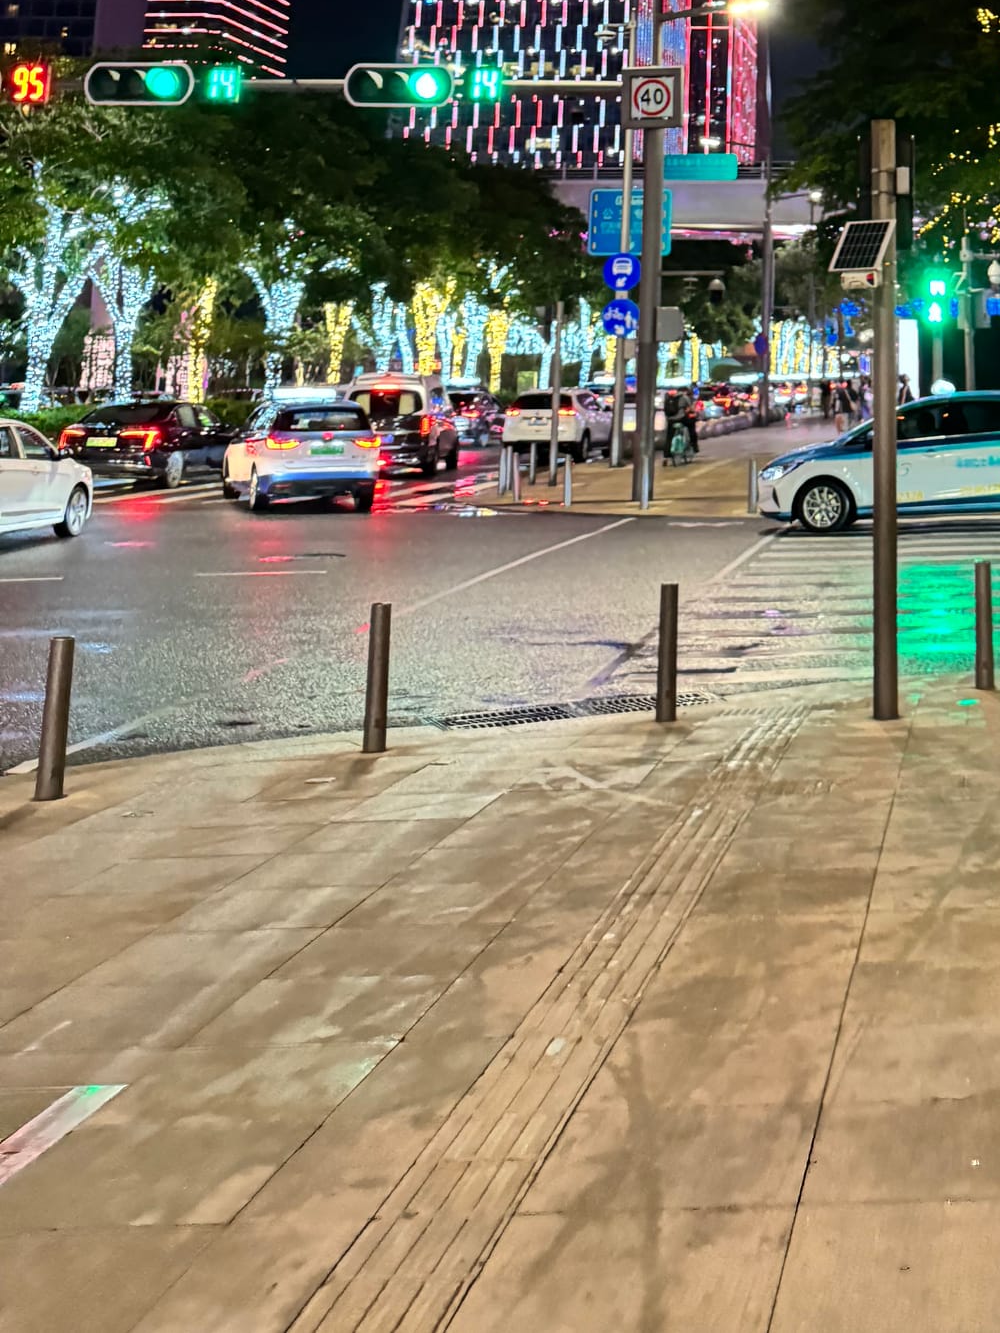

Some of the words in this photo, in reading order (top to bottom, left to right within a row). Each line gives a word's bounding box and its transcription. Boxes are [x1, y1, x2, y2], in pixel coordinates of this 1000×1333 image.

[13, 67, 44, 101] 95
[209, 69, 234, 99] 14
[472, 69, 499, 99] 14
[640, 88, 664, 105] 40
